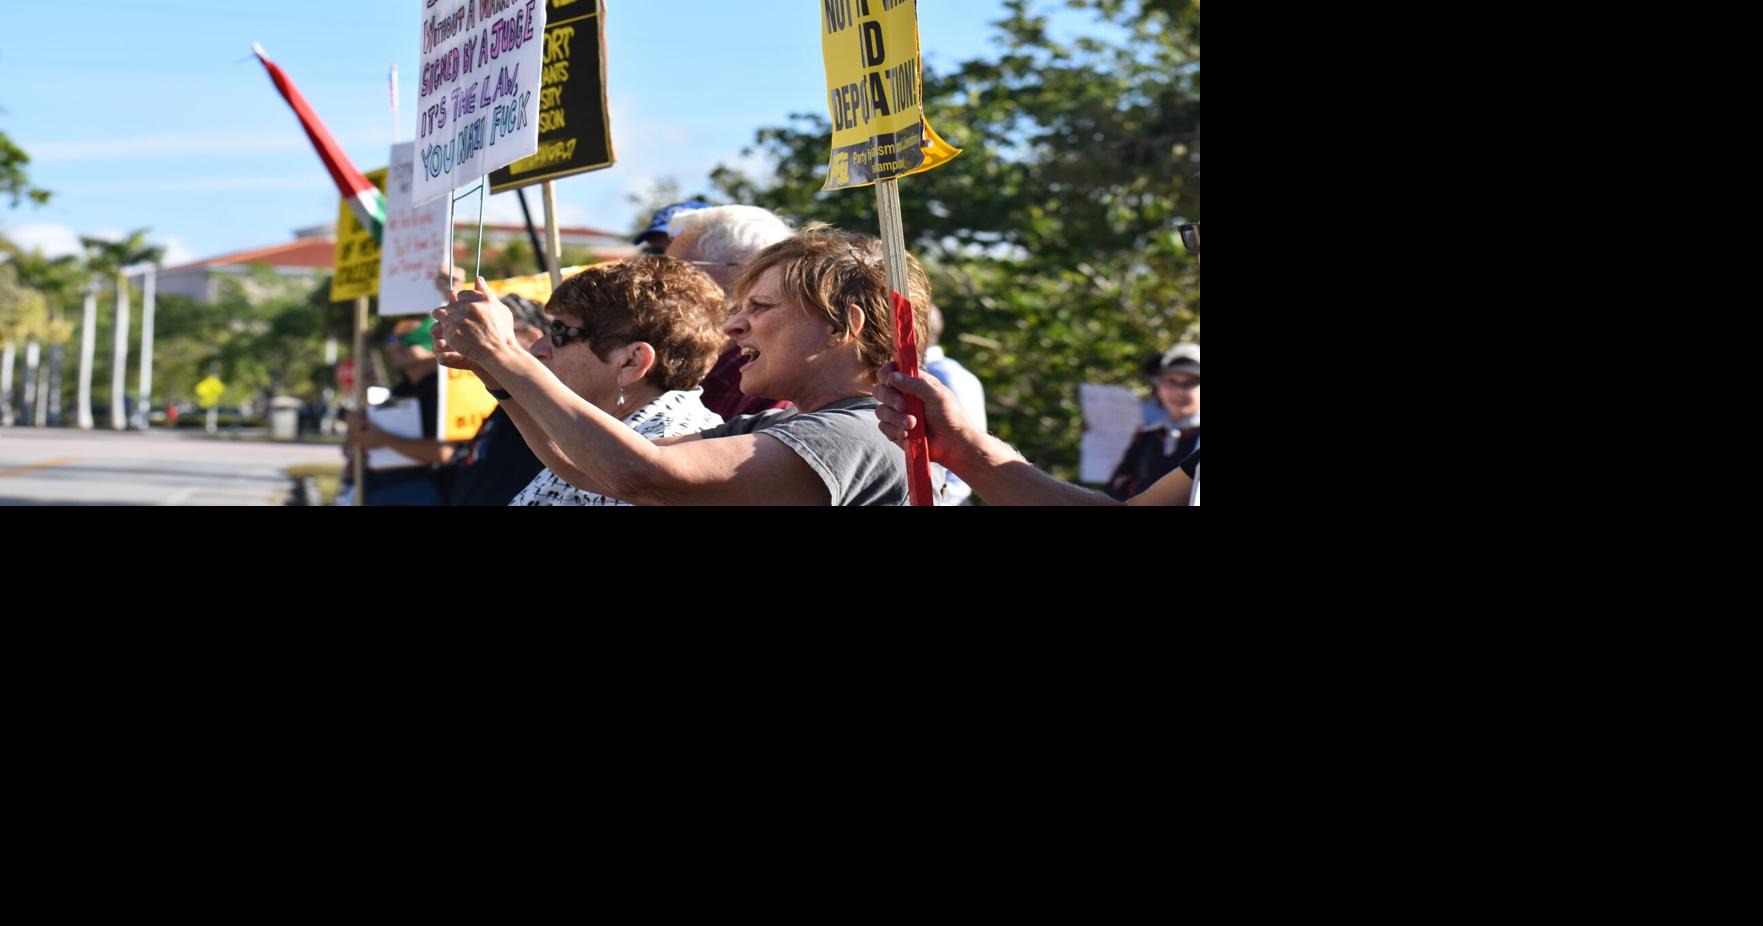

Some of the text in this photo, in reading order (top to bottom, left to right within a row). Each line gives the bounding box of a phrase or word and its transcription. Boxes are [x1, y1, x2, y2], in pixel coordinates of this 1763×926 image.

[421, 0, 536, 98] SIGNED BY A JUDGE
[543, 26, 575, 63] ORT
[541, 60, 570, 86] ANTS
[421, 96, 447, 138] IT'S
[451, 82, 478, 122] THE
[538, 107, 566, 134] SION
[421, 139, 455, 181] YOU
[457, 115, 485, 165] NAZI
[490, 90, 531, 146] FUCK
